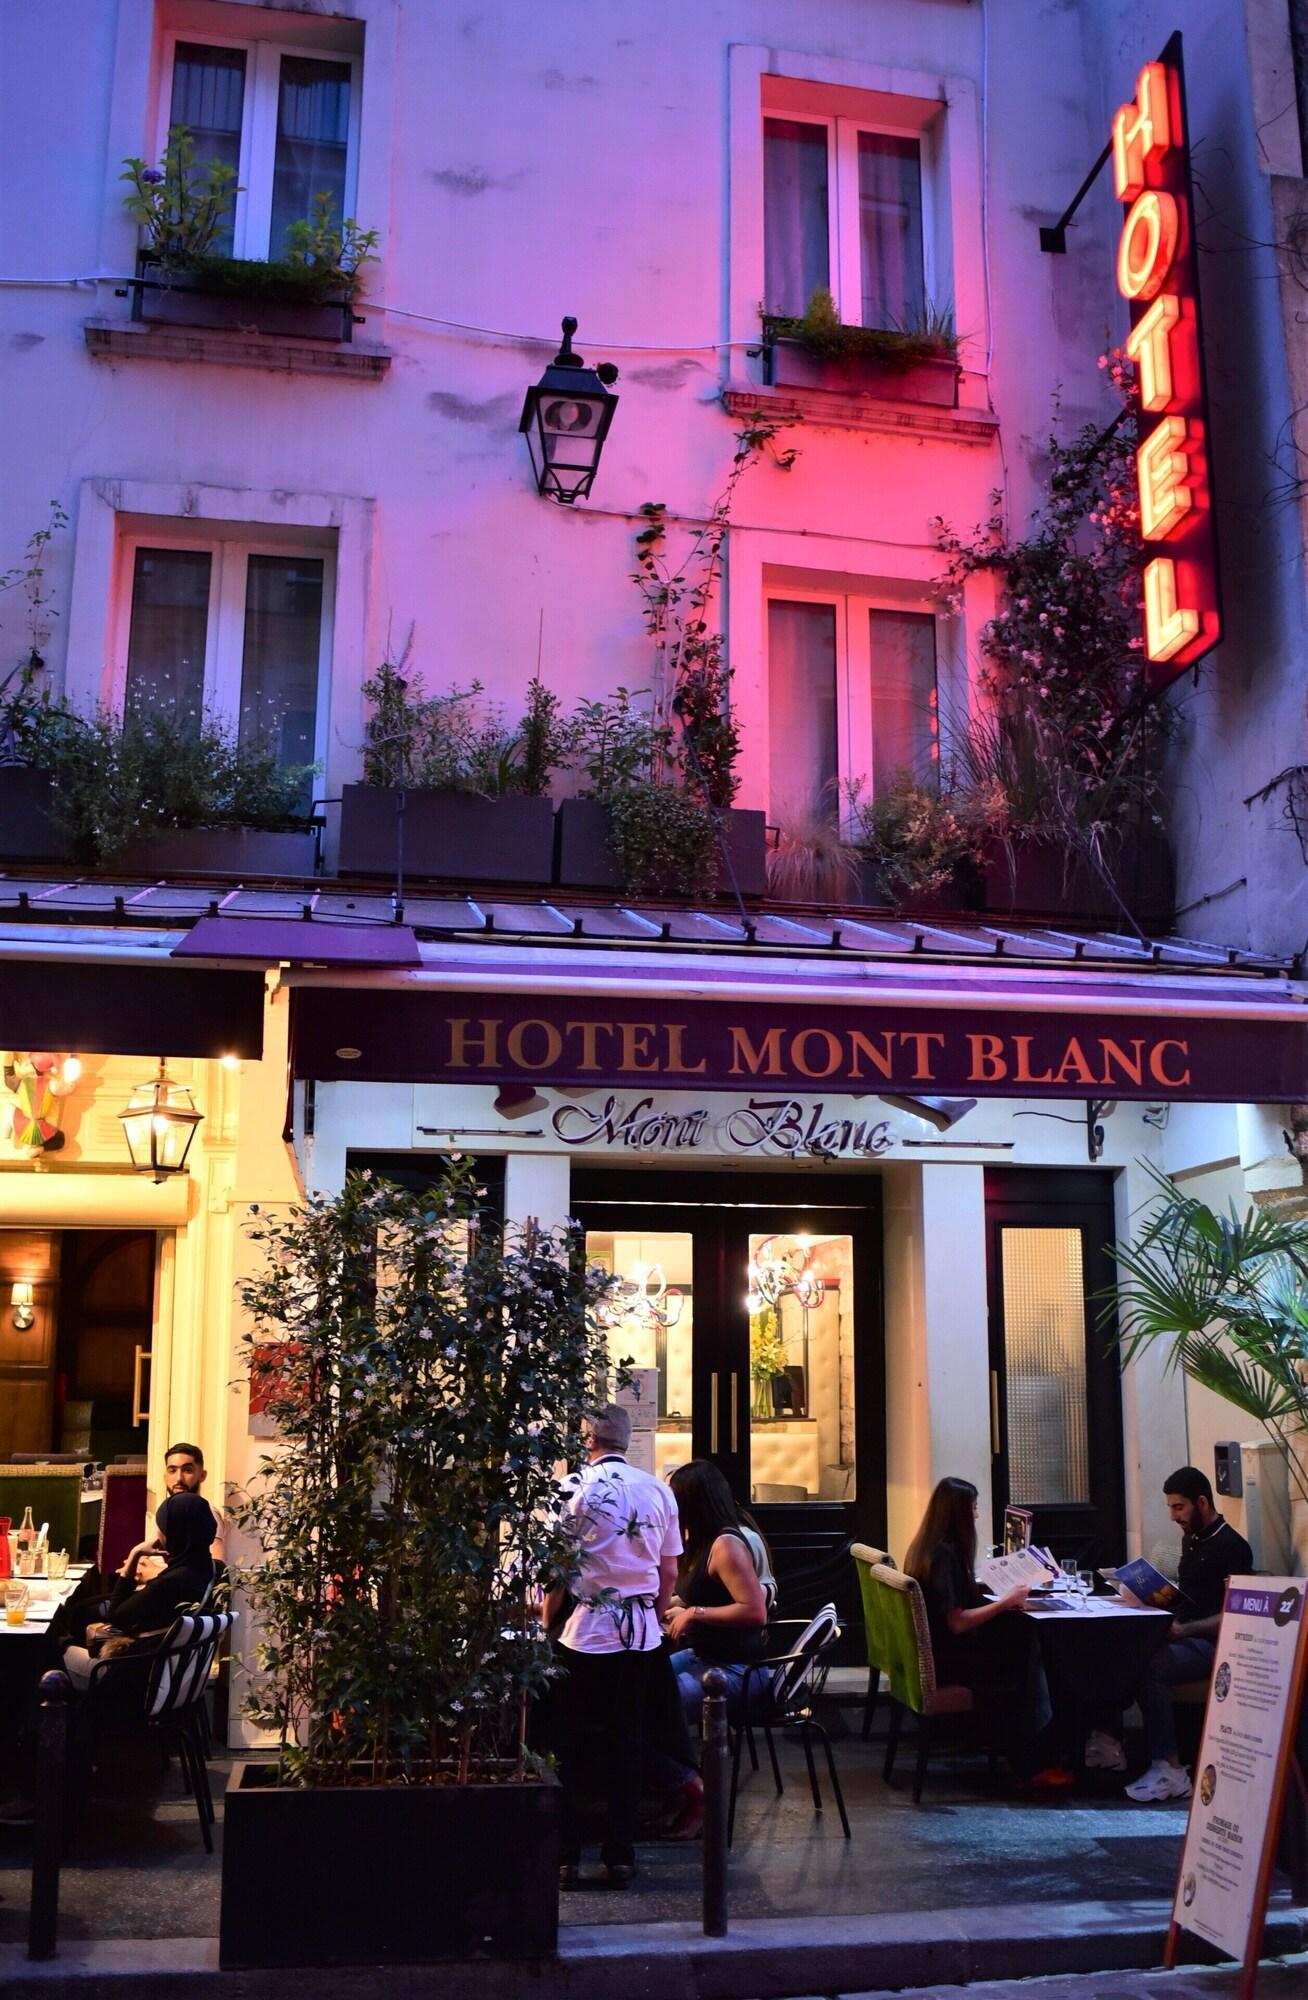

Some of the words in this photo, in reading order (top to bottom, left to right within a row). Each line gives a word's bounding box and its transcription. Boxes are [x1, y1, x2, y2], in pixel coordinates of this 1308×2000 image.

[1113, 60, 1200, 663] HOTEL
[445, 1018, 706, 1074] HOTEL
[727, 1026, 945, 1080] MONT
[966, 1033, 1191, 1087] BLANC
[552, 1096, 709, 1146] Mont
[727, 1098, 897, 1152] Blanc
[1242, 1597, 1263, 1612] MENU
